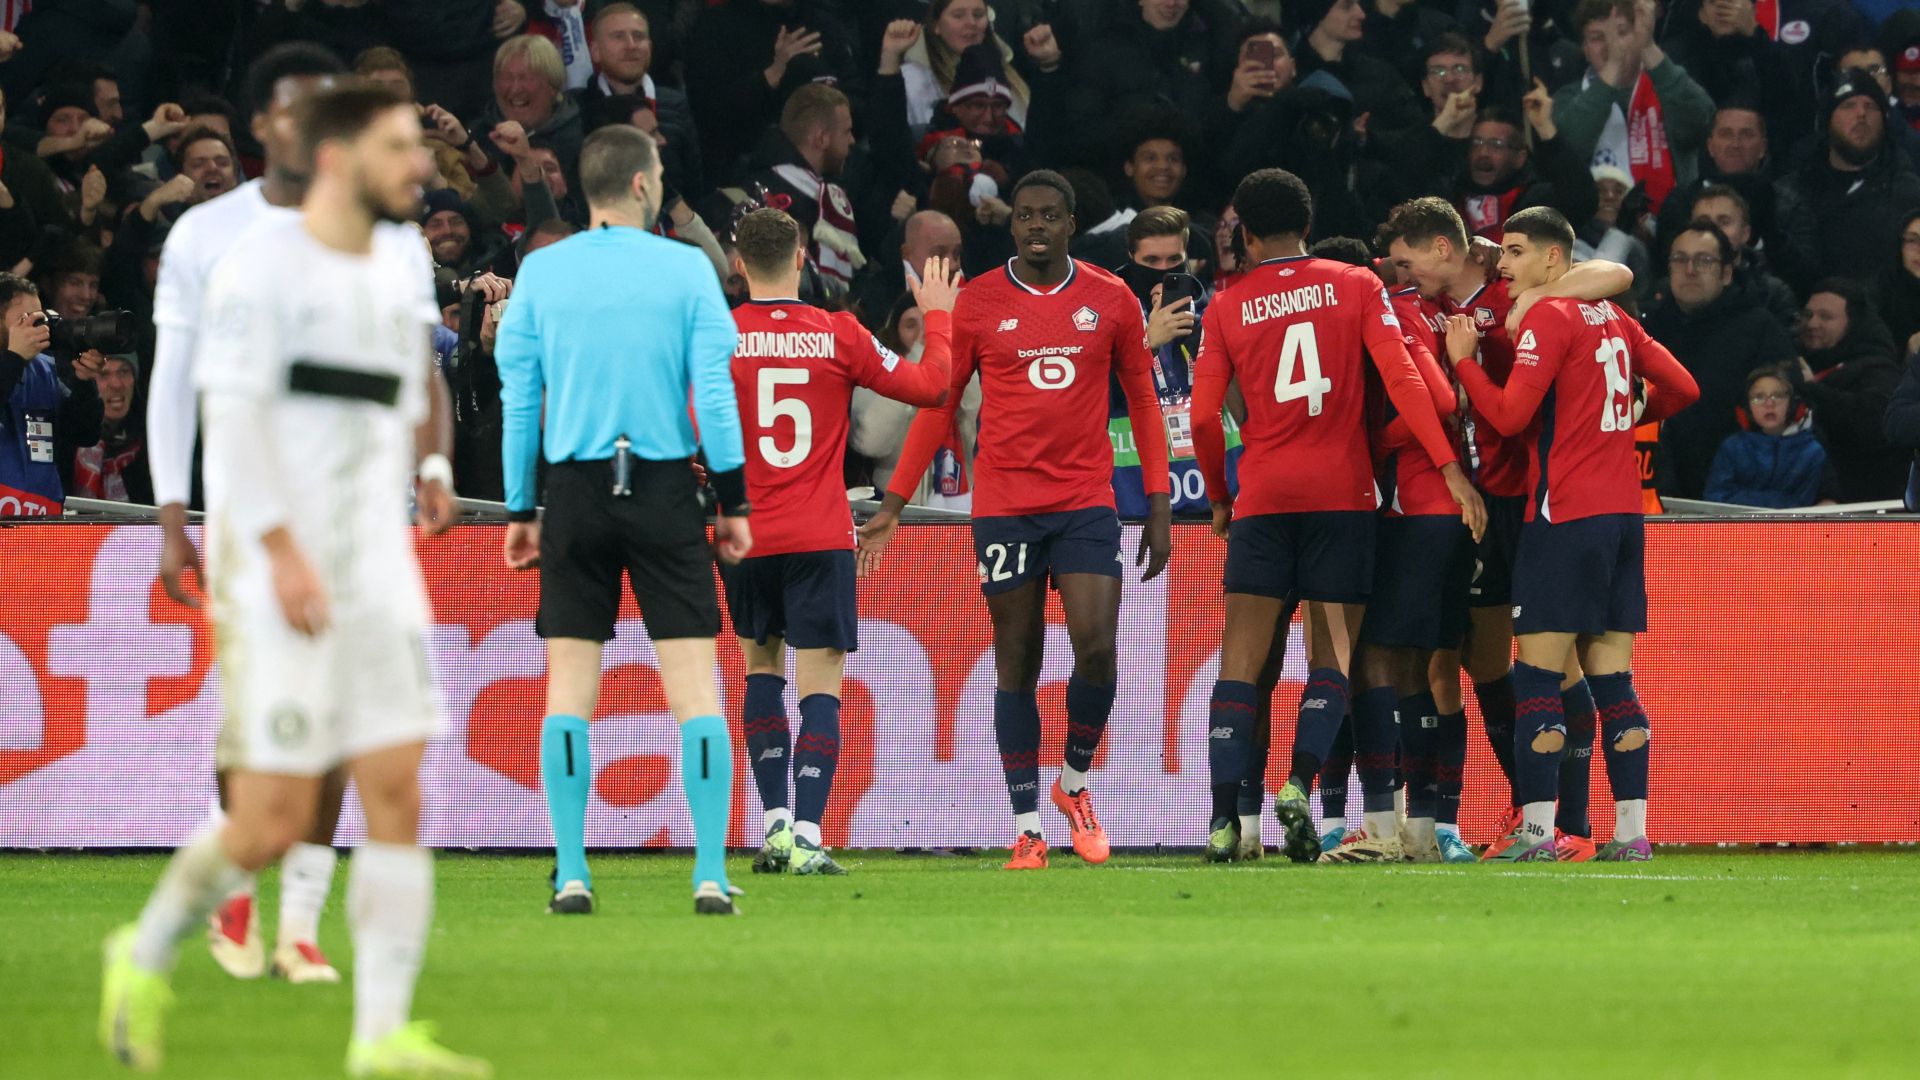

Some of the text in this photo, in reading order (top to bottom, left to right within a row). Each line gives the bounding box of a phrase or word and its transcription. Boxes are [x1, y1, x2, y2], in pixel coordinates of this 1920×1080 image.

[1242, 283, 1338, 326] ALEXSANDRO R.
[735, 331, 835, 359] GUDMUNDSSON
[1017, 345, 1083, 358] boulanger
[1274, 321, 1332, 417] 4
[1594, 336, 1633, 433] 19
[757, 367, 812, 469] 5
[986, 542, 1028, 582] 27
[1526, 822, 1545, 838] 316
